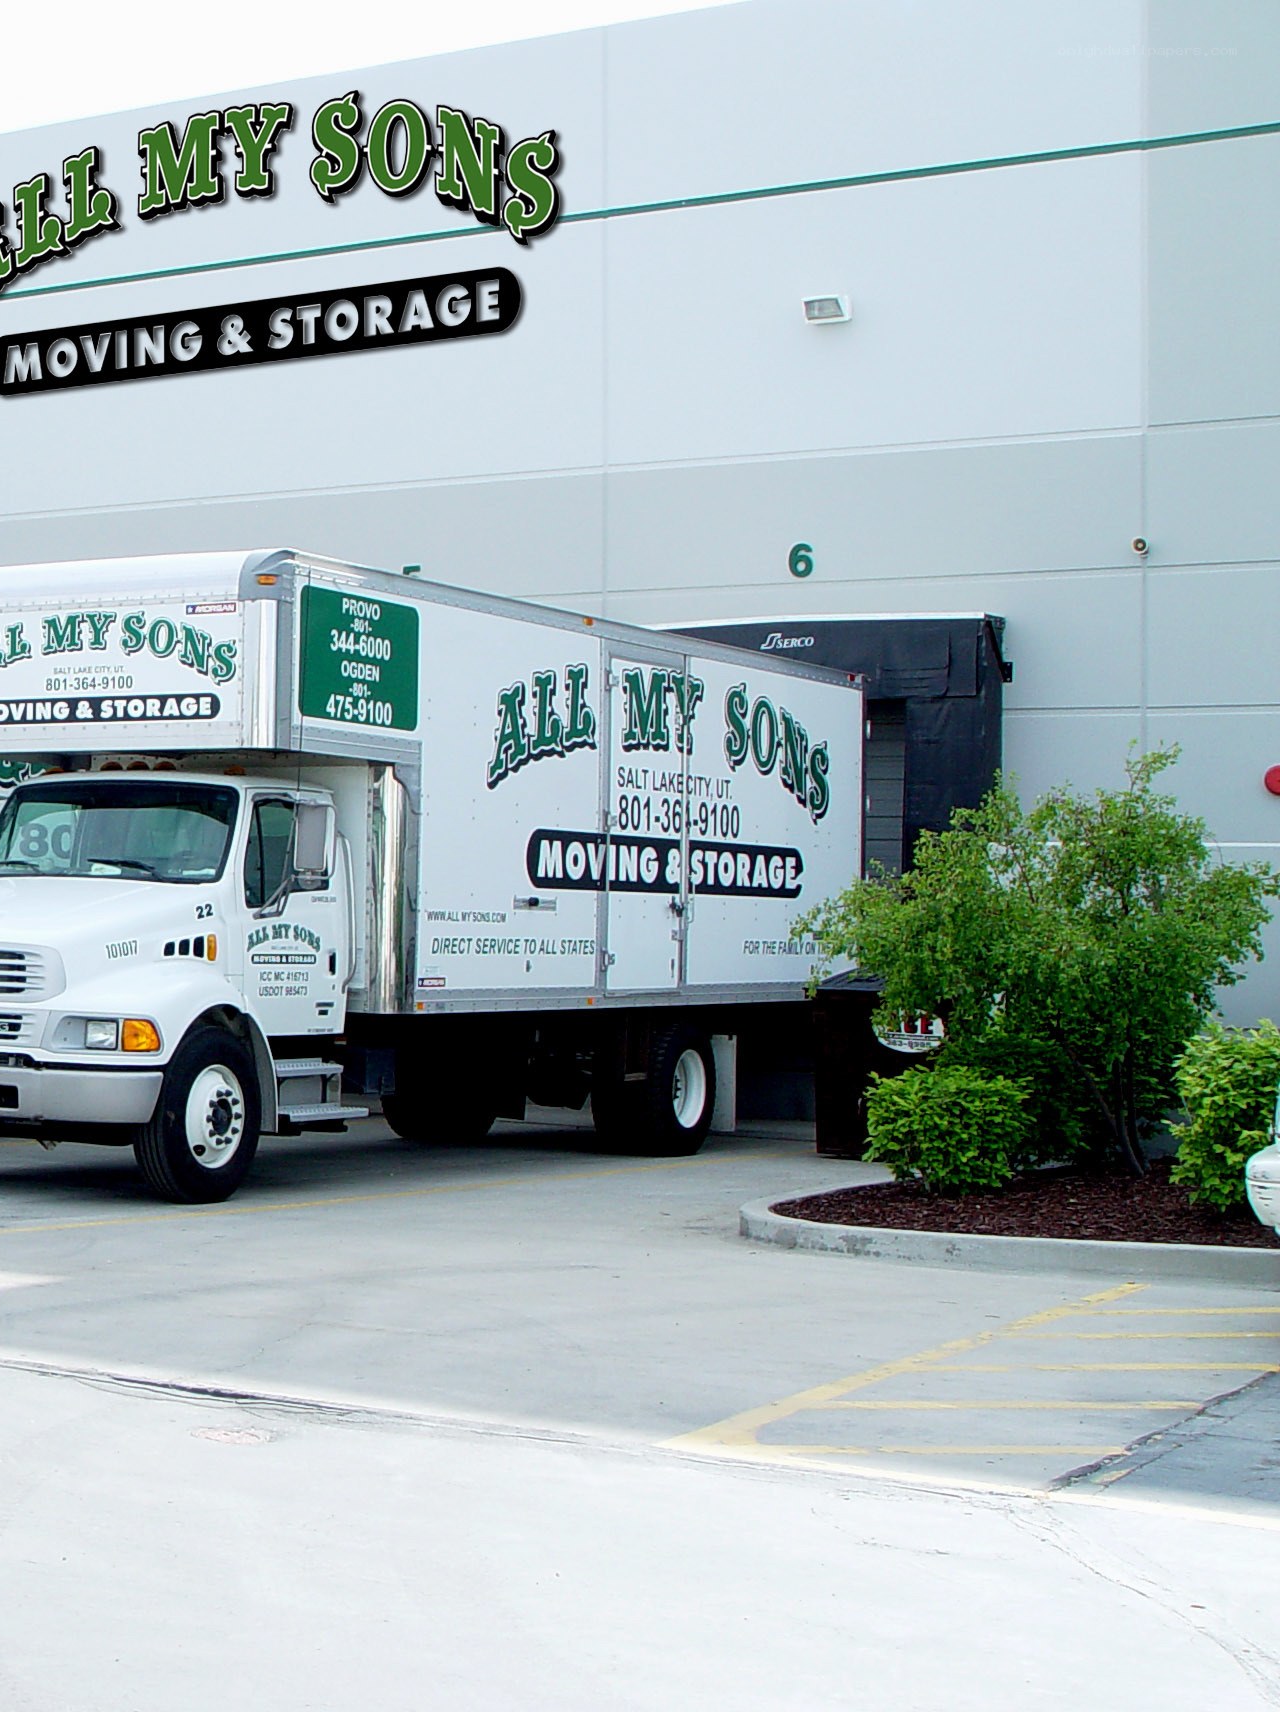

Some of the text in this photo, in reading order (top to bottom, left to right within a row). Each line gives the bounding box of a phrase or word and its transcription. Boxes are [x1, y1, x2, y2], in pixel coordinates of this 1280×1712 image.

[138, 101, 294, 221] MY
[310, 90, 561, 248] SONS
[3, 280, 500, 384] MOVING & STORAGE
[788, 542, 813, 578] 6
[195, 603, 235, 613] MORGAN
[342, 597, 381, 621] PROVO
[42, 611, 117, 655] MY
[121, 610, 237, 686] SONS
[330, 629, 392, 661] 344-6000
[73, 666, 92, 674] LAKE
[341, 660, 380, 682] OGDEN
[45, 675, 133, 692] 801-364-9100
[76, 701, 94, 718] &
[100, 696, 212, 718] STORAGE
[325, 693, 393, 726] 475-9100
[486, 663, 830, 826] ALL MY SONS
[617, 766, 733, 801] SALT LAKE CITY, UT.
[537, 838, 802, 890] MOVING & STORAGE
[196, 904, 214, 919] 22
[106, 940, 138, 959] 101017
[247, 926, 269, 952] ALL
[272, 924, 291, 940] MY
[431, 937, 595, 955] DIRECT SERVICE TO ALL STATES
[743, 940, 760, 954] FOR
[762, 941, 776, 954] THE
[778, 941, 803, 955] FAMILY
[260, 972, 272, 981] ICC
[274, 972, 285, 981] MC
[259, 986, 283, 996] USDOT
